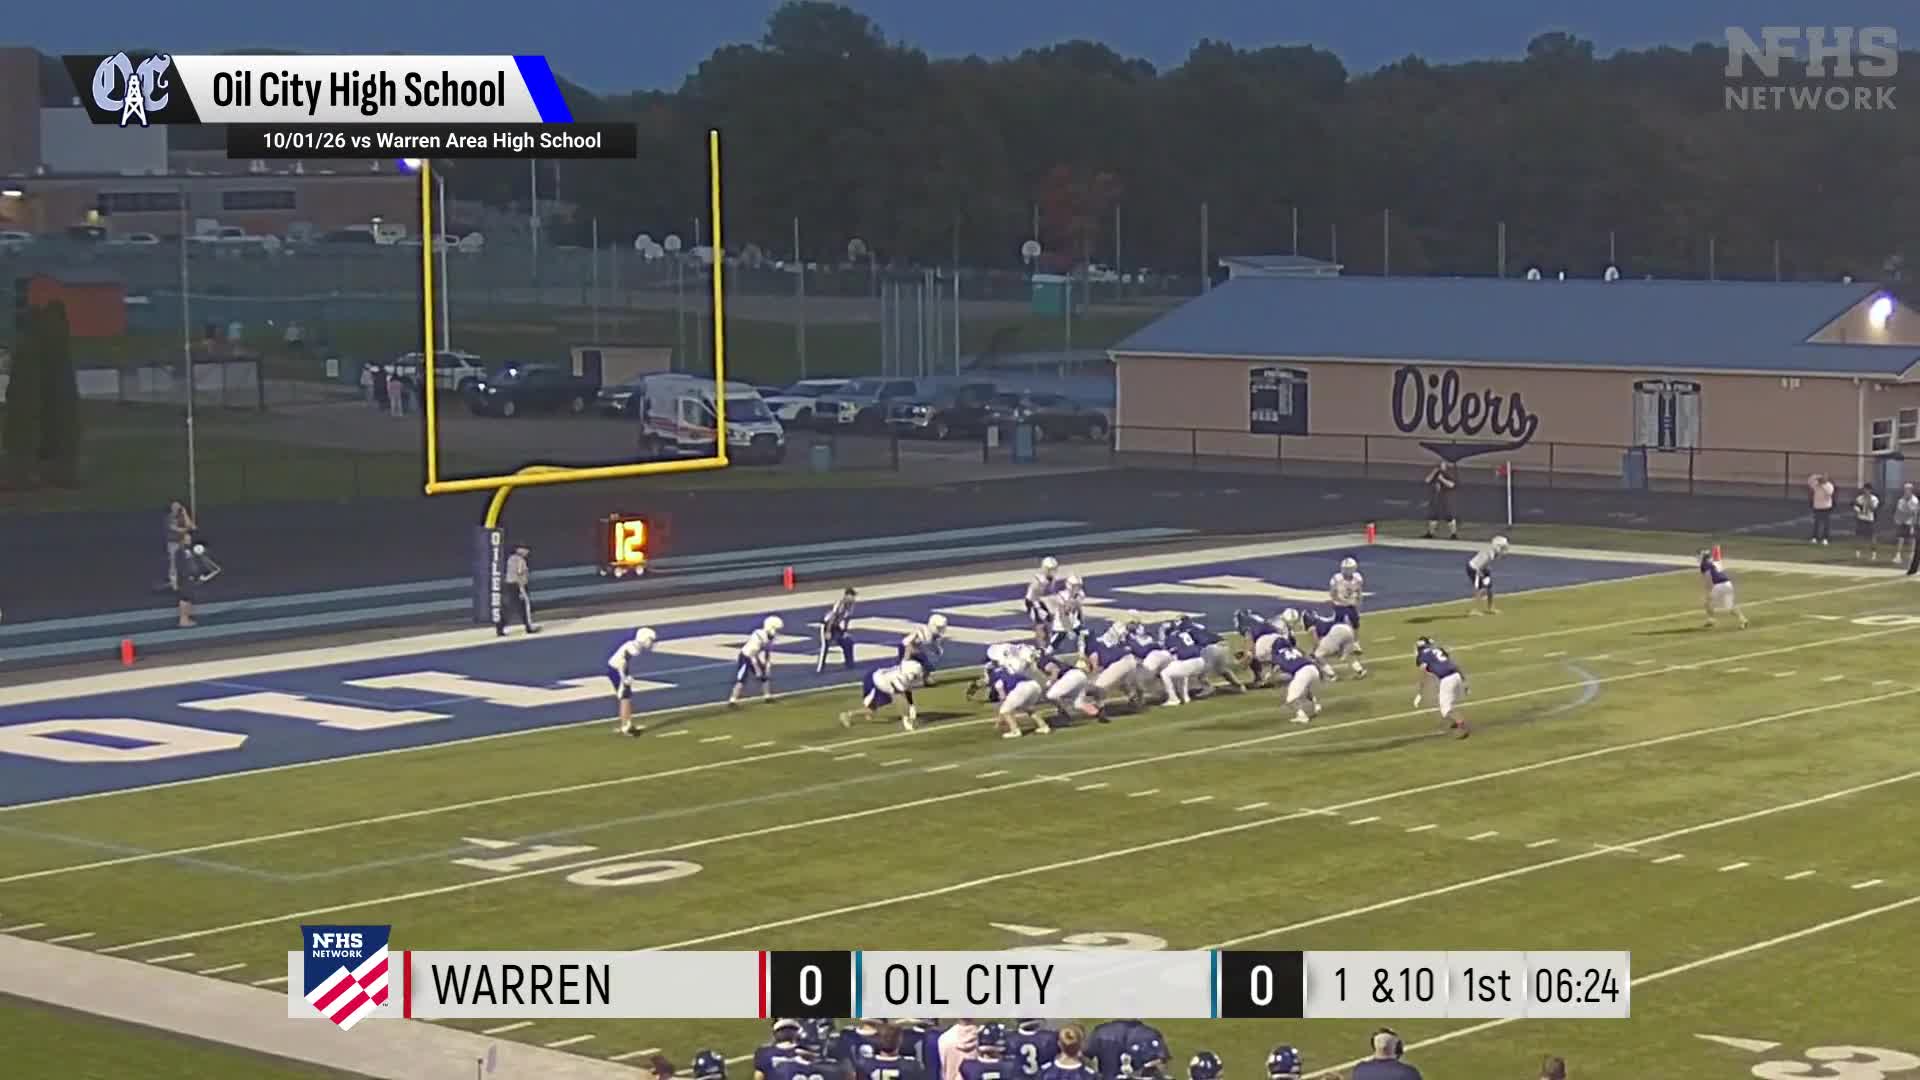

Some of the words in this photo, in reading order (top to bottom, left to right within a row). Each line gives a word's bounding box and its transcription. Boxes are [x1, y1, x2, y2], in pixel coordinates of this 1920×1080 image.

[1392, 365, 1538, 441] Oilers
[615, 519, 645, 562] 12
[1020, 1044, 1038, 1075] 3
